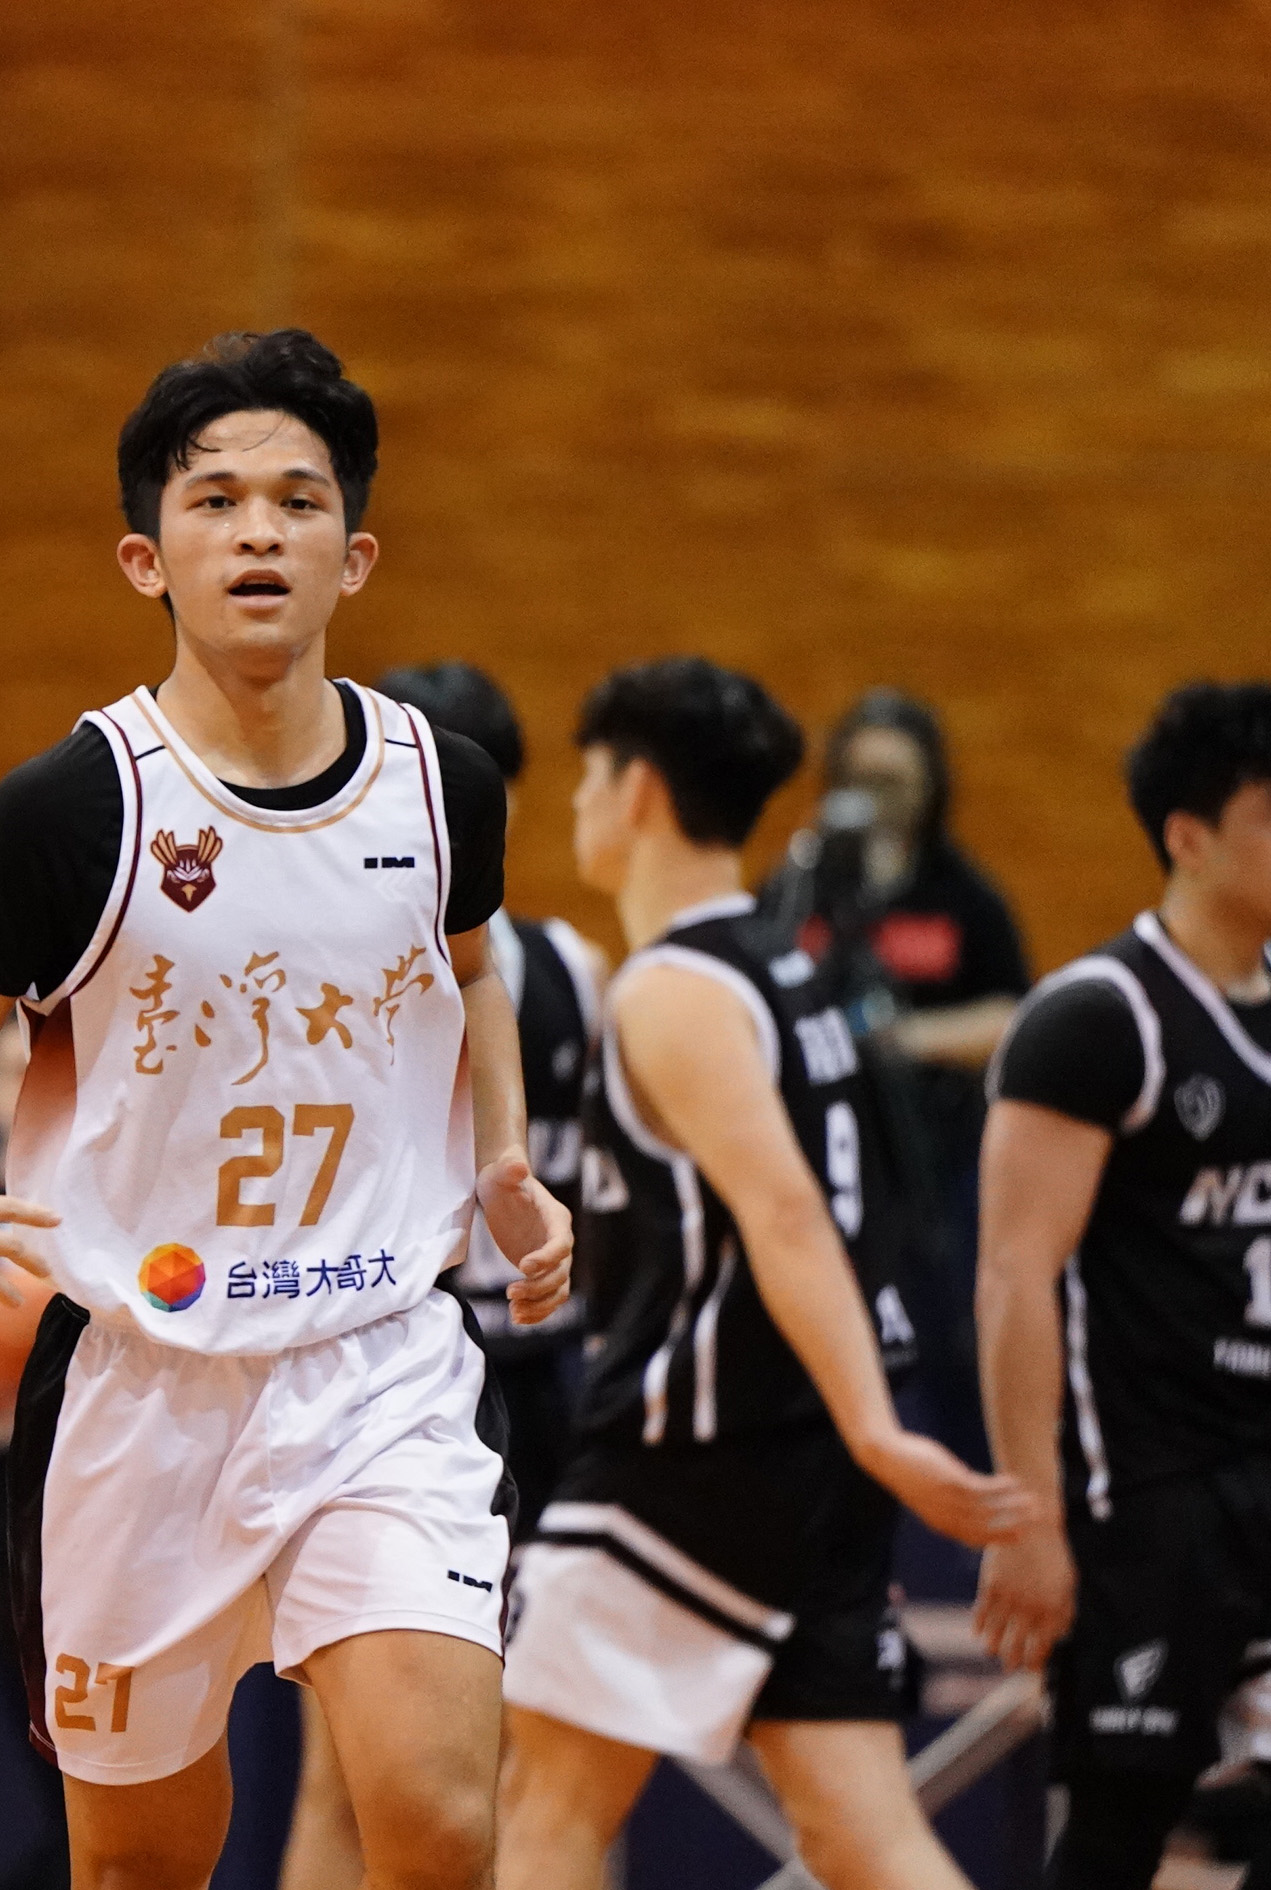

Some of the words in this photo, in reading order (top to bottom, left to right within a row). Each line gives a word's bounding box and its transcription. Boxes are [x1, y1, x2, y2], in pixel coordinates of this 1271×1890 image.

[216, 1103, 356, 1228] 27
[227, 1248, 397, 1300] 台灣大哥大
[54, 1652, 136, 1733] 27
